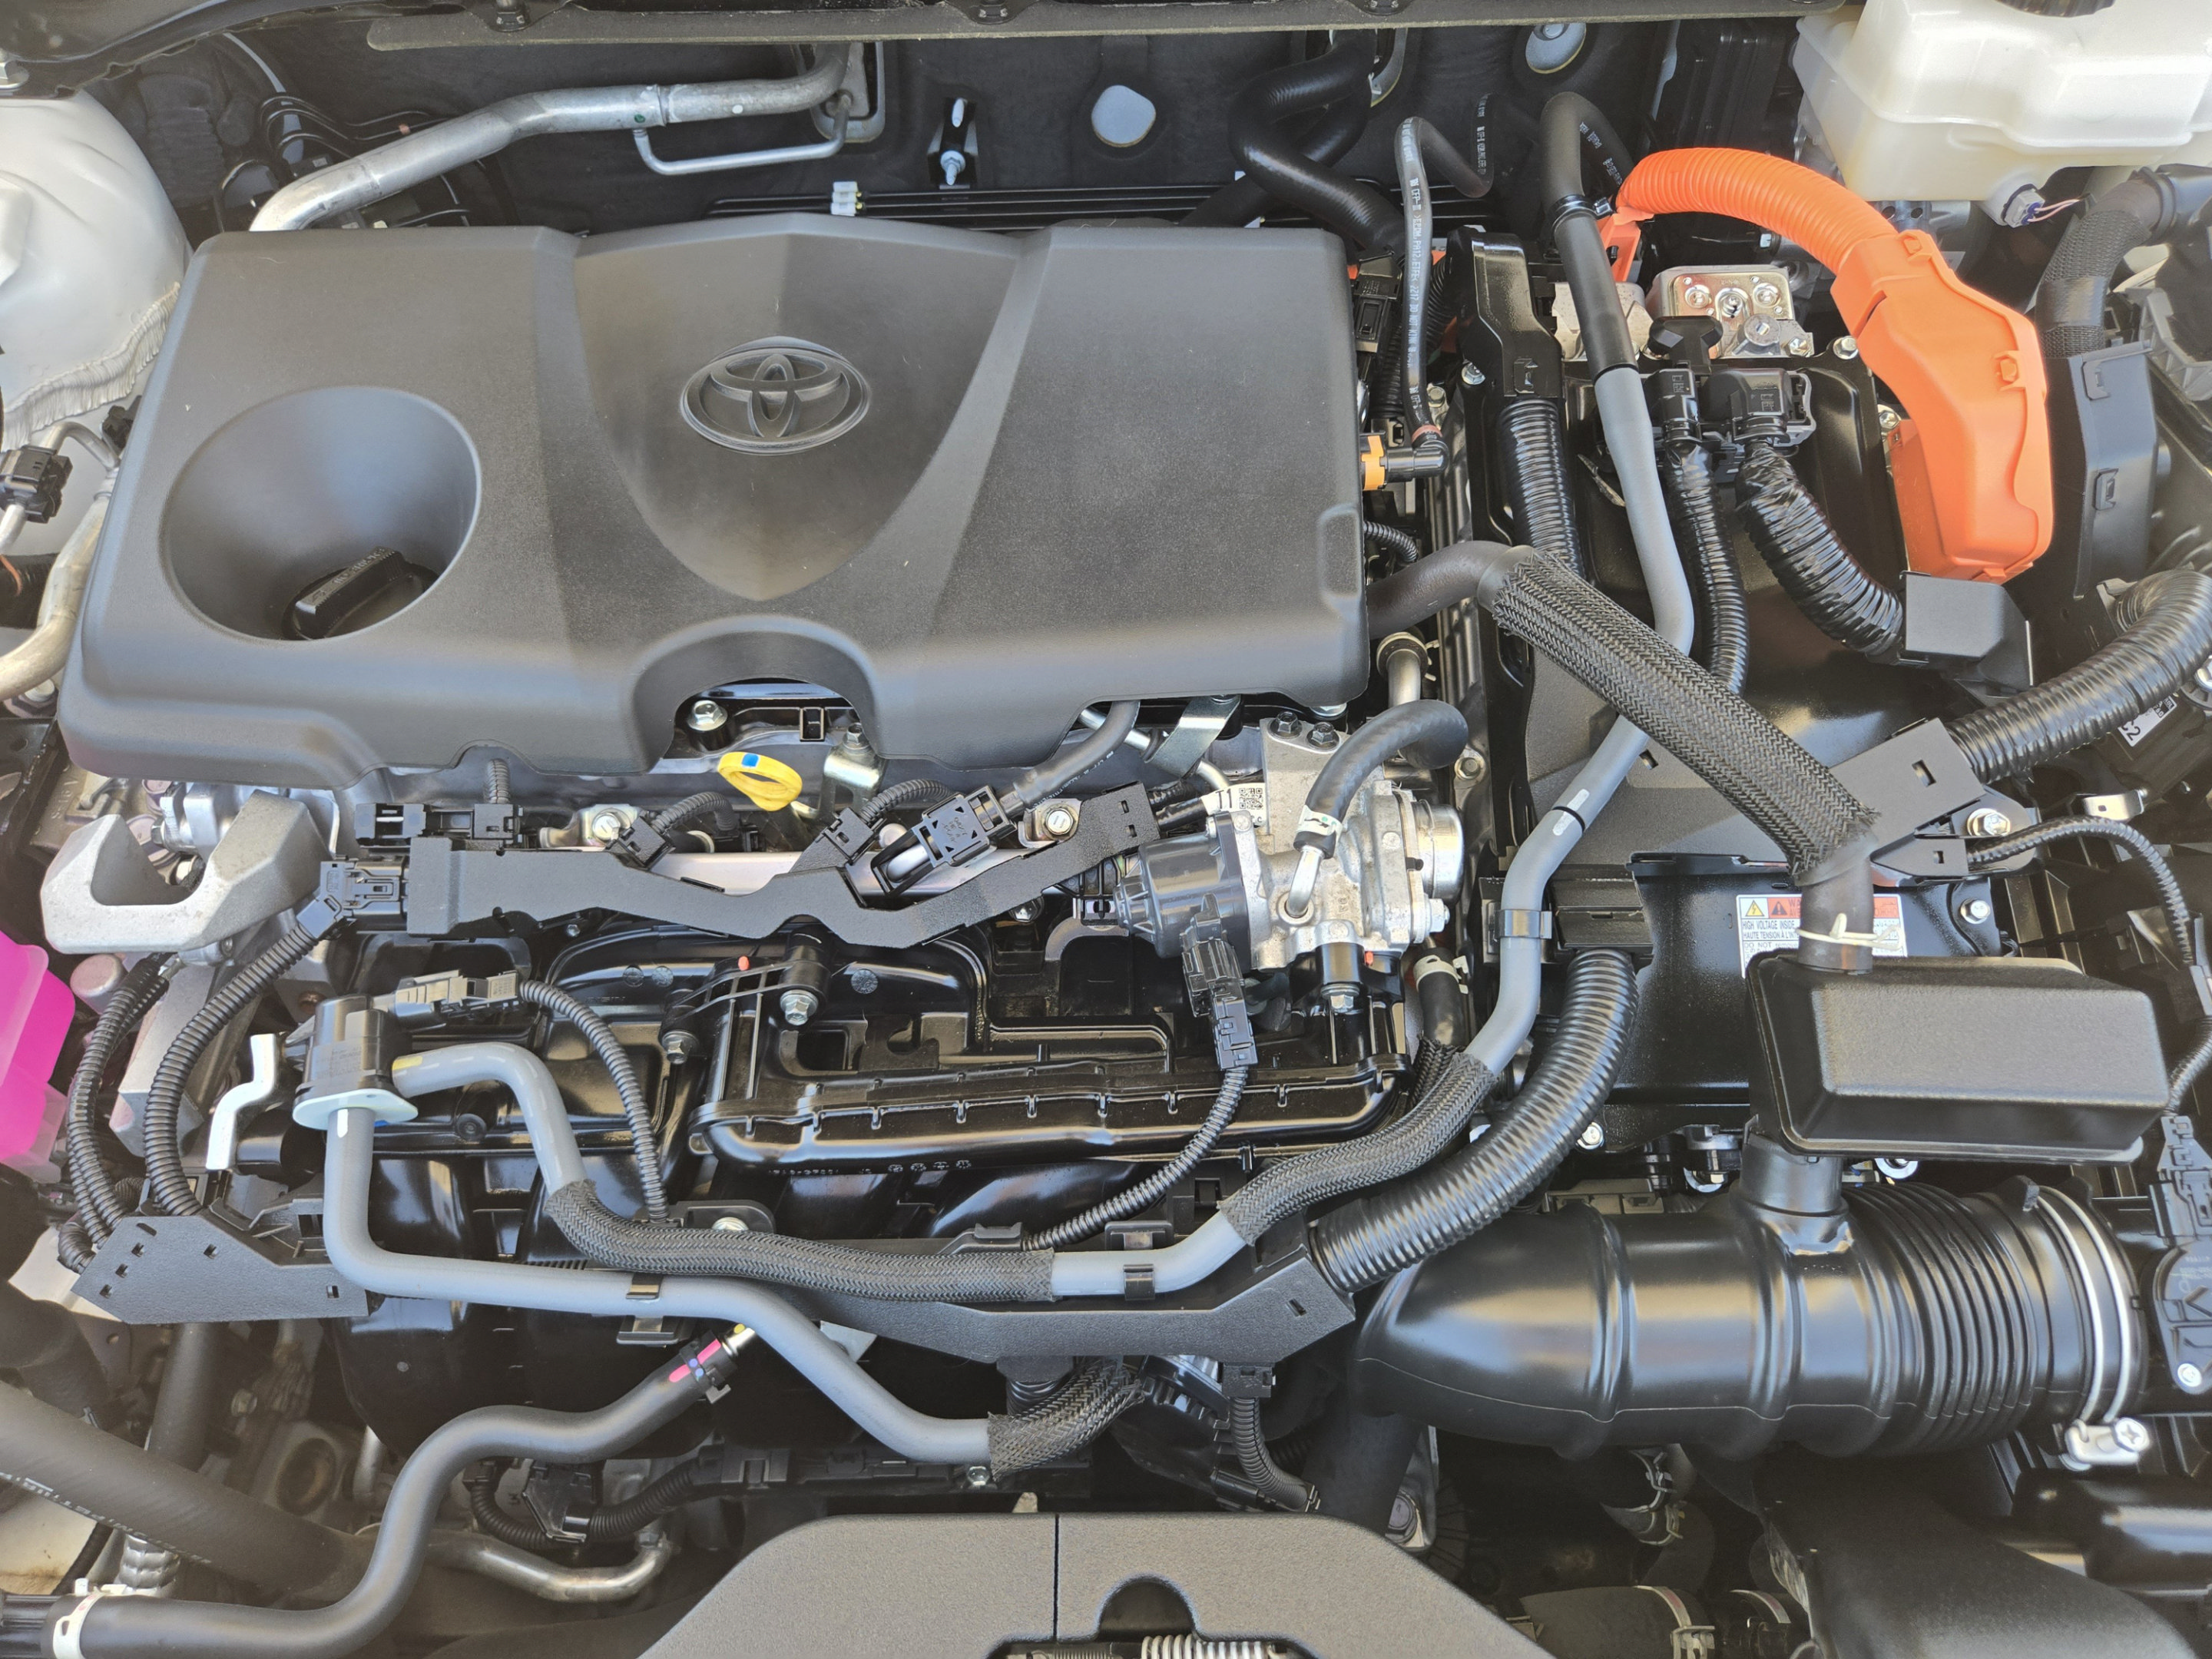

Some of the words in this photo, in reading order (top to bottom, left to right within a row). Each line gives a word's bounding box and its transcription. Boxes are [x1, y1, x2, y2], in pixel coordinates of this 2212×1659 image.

[1215, 788, 1232, 810] T1
[1743, 920, 1754, 929] HIGH
[1756, 920, 1778, 929] VOLTAGE
[1743, 931, 1759, 939] HAUTE
[1760, 931, 1781, 939] TENSION
